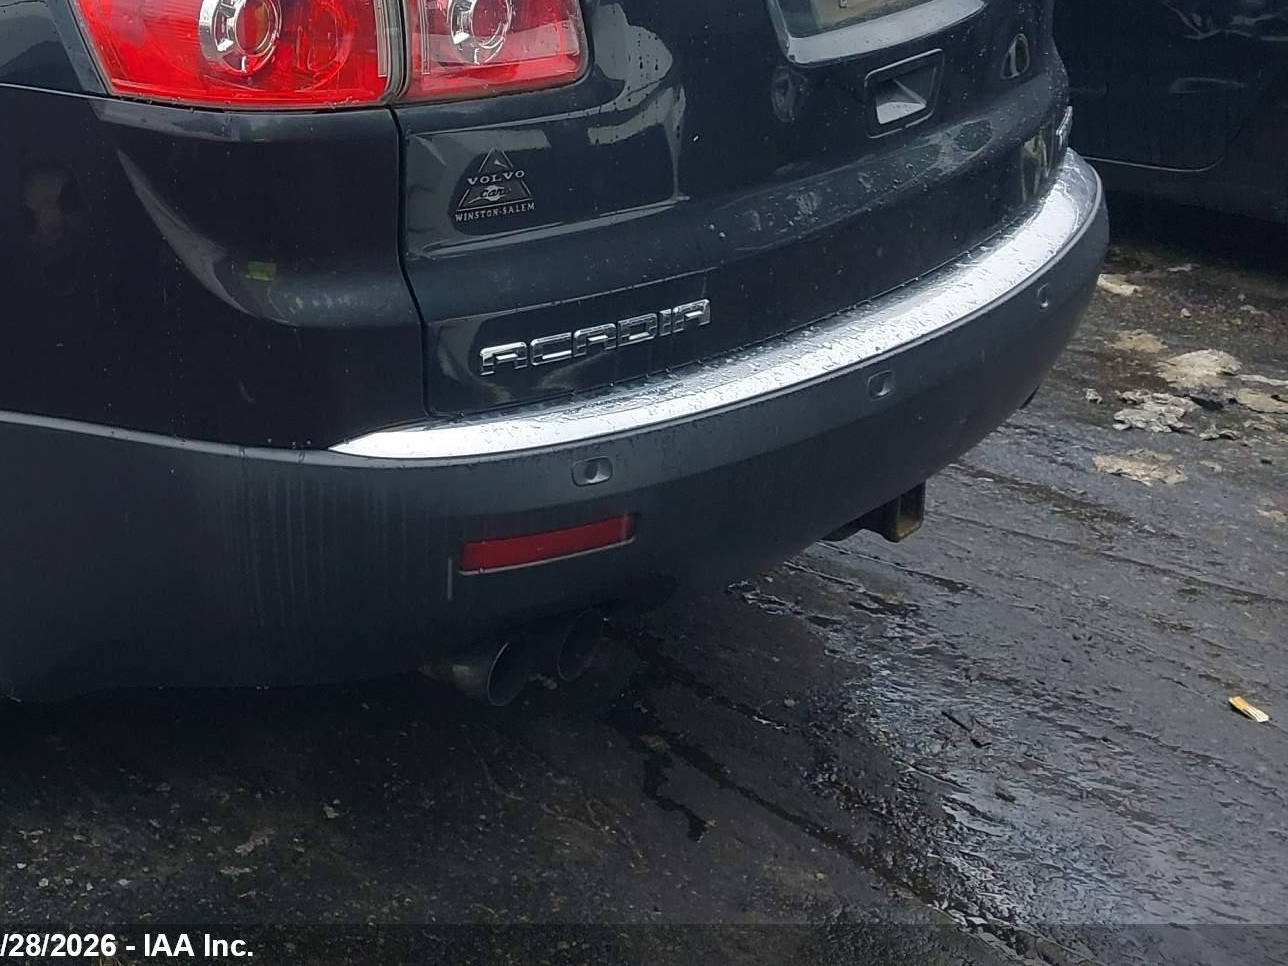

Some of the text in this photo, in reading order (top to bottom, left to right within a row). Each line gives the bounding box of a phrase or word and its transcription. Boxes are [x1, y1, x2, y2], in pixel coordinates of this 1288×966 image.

[466, 170, 525, 186] VOLVO
[455, 202, 535, 223] WINSTON-SALEM
[479, 298, 711, 376] ACADIA
